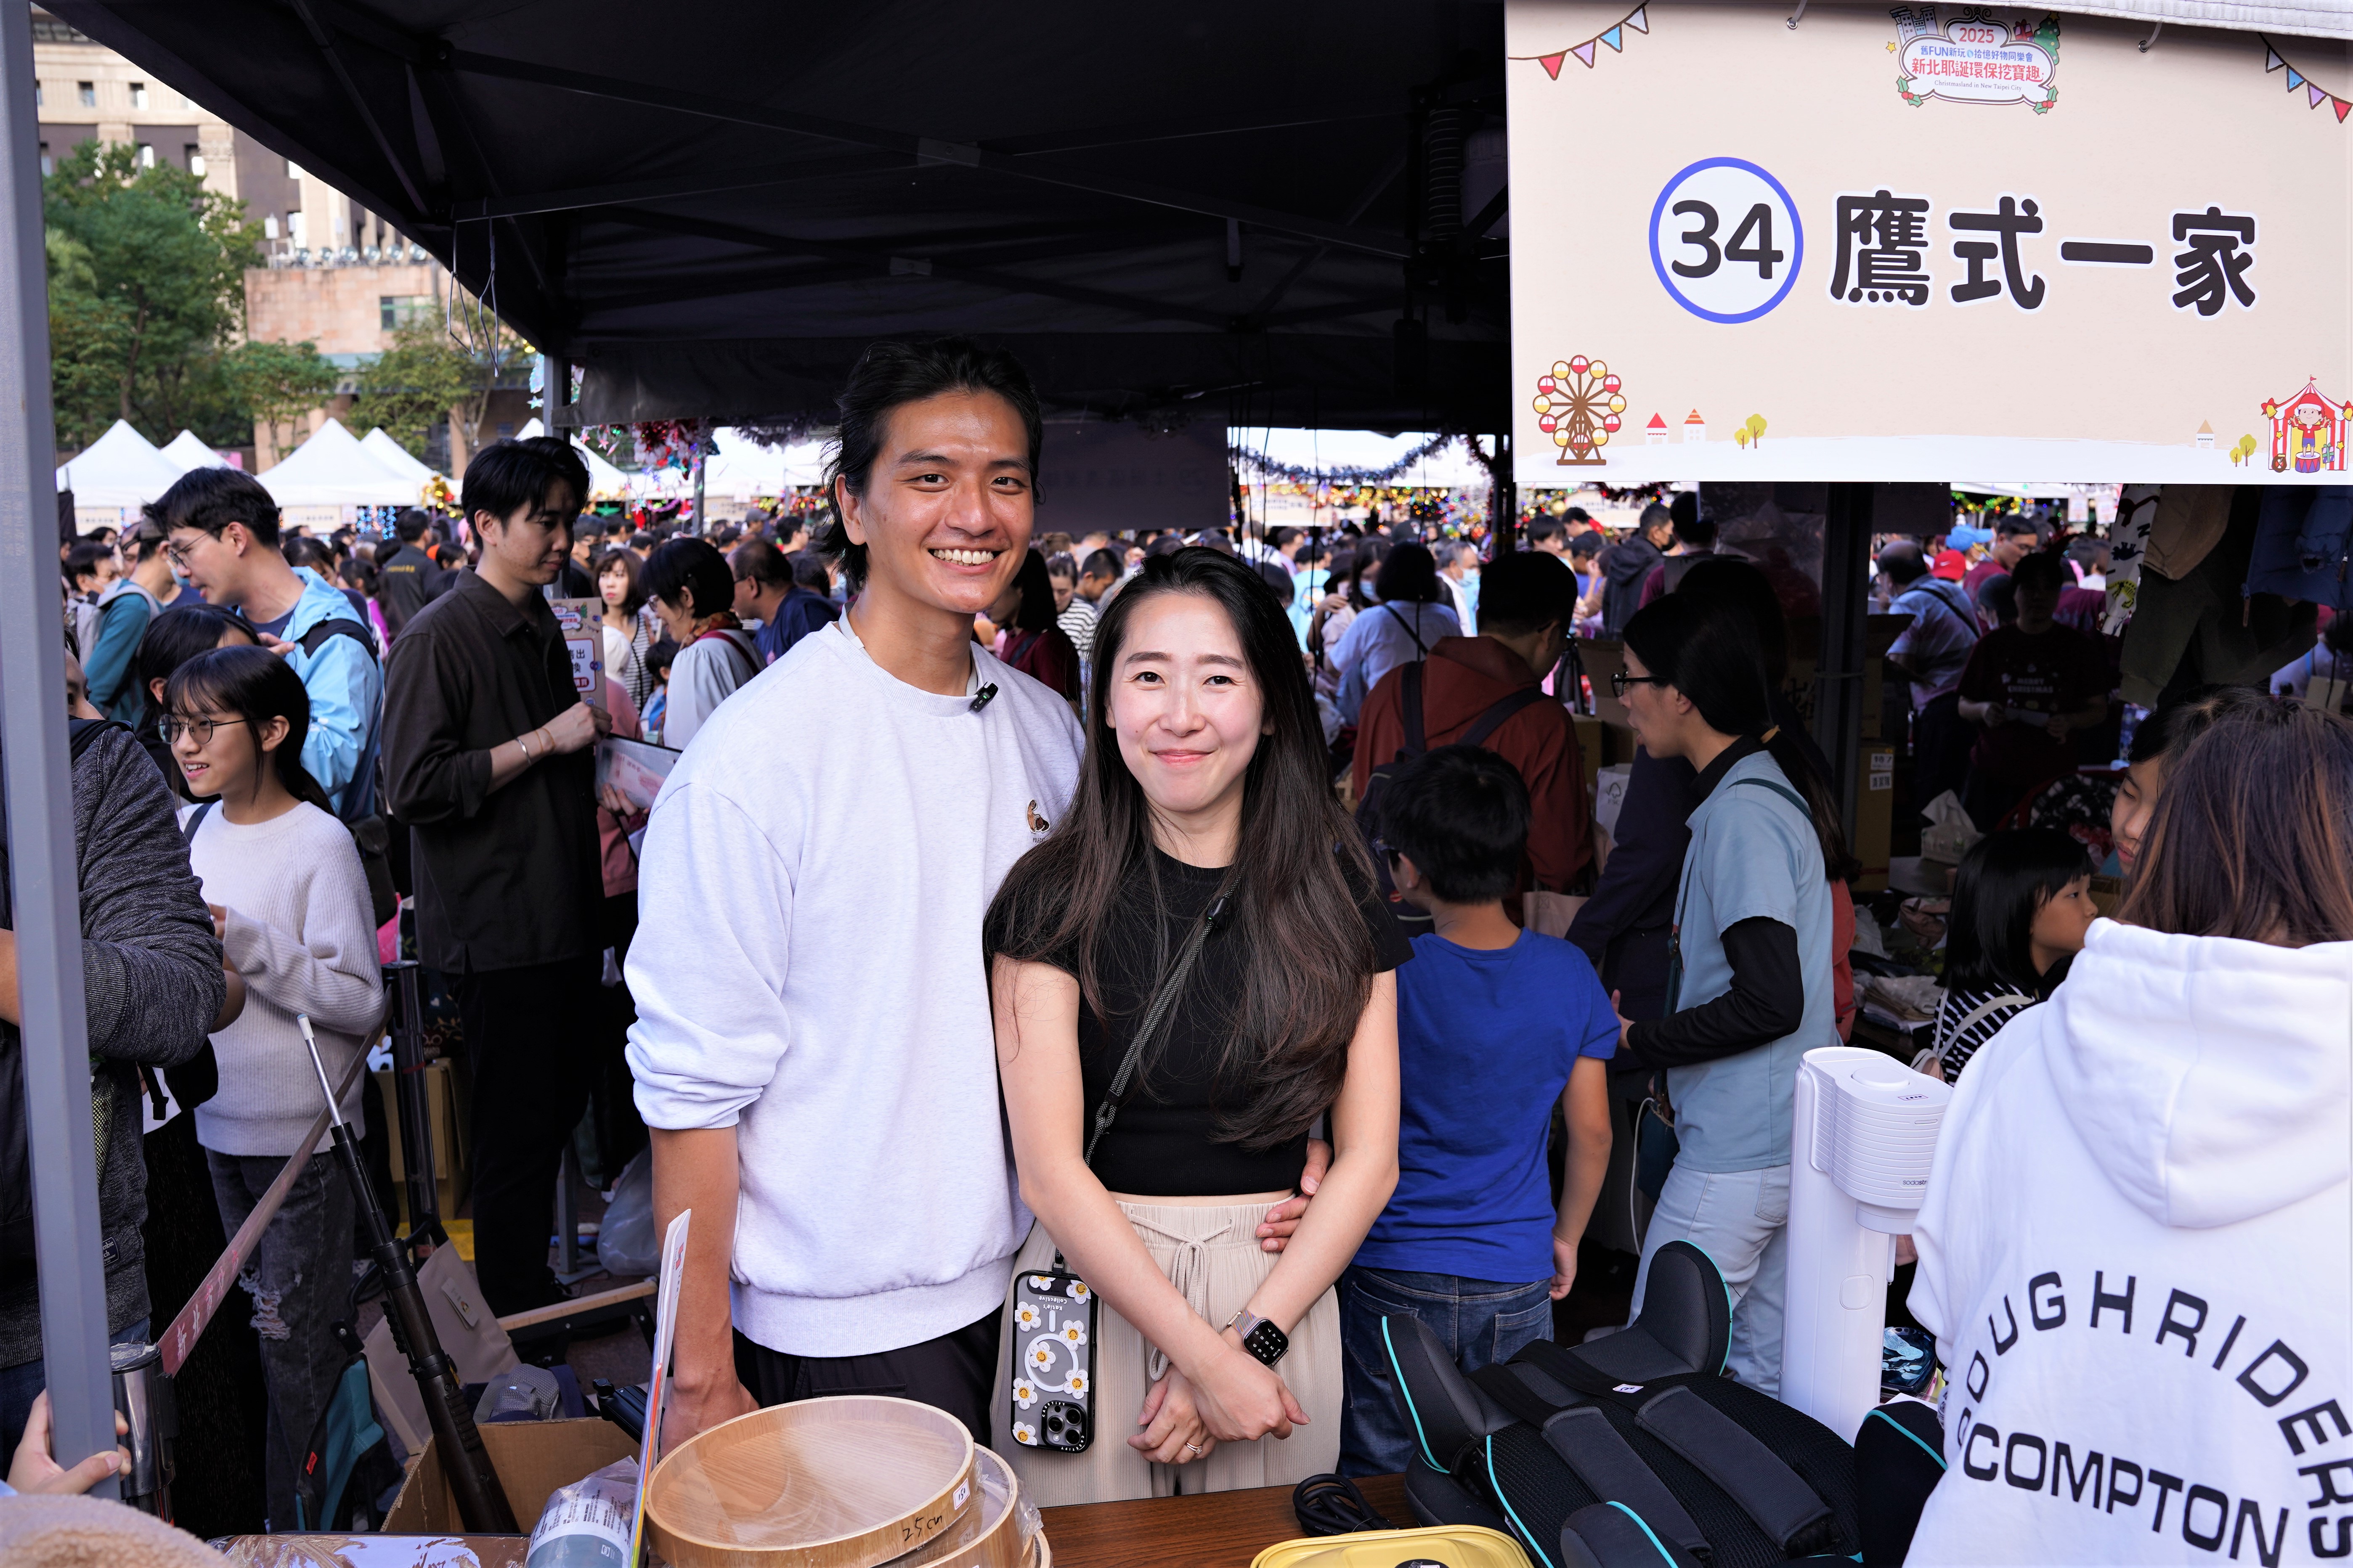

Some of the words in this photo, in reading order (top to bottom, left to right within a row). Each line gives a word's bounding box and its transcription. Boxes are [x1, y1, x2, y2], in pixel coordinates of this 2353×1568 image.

[1959, 27, 1995, 43] 2025
[1921, 45, 1966, 58] 舊FUN新玩
[1974, 49, 2033, 62] 拾憶好物同樂會
[1912, 58, 2044, 82] 新北耶誕環保挖寶趣
[1672, 200, 1784, 279] 34
[1830, 190, 2255, 316] 鷹式一家
[2006, 685, 2054, 694] CHRISTMAS
[1039, 1295, 1067, 1304] Collective
[1042, 1401, 1065, 1417] CASETIFY
[1061, 1435, 1085, 1451] CASETIFY
[1964, 1424, 2289, 1568] COMPTON
